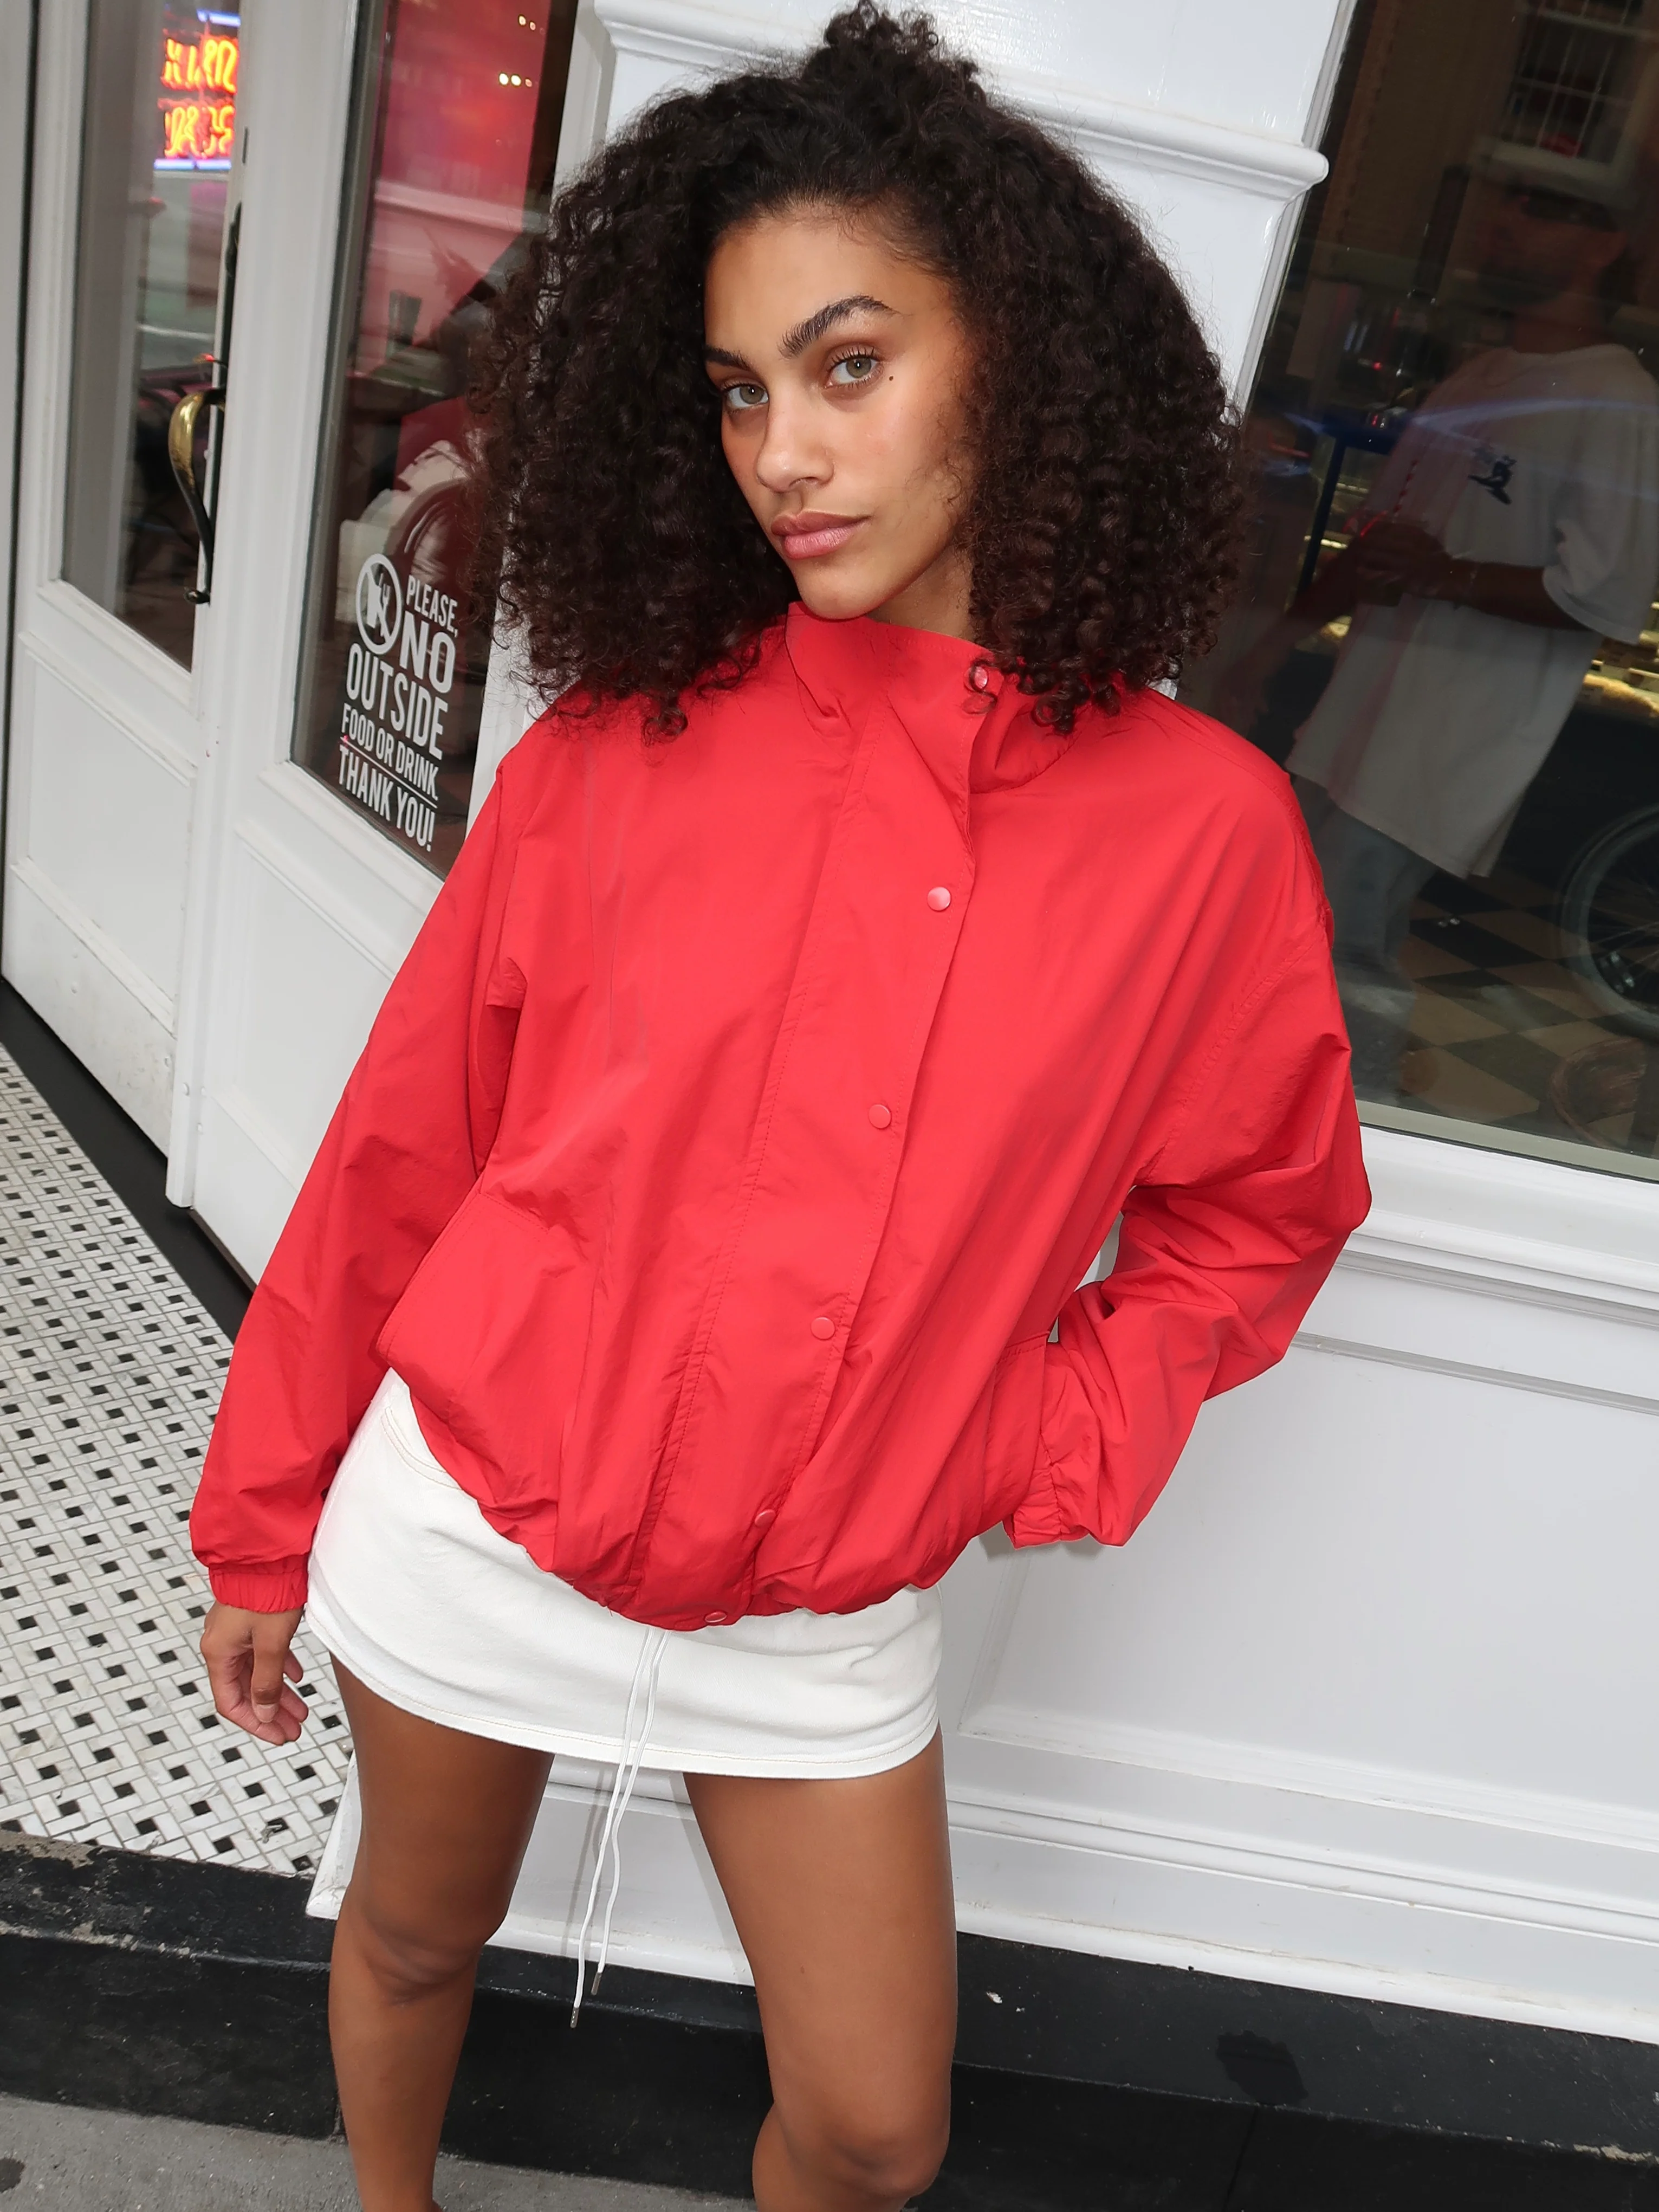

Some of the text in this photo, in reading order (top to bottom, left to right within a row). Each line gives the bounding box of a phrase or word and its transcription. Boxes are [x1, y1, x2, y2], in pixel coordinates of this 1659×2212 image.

[406, 574, 458, 638] PLEASE,
[399, 610, 456, 694] NO
[341, 702, 375, 752] FOOD
[375, 727, 394, 768] OR
[346, 643, 448, 761] OUTSIDE
[339, 743, 436, 852] THANK YOU!
